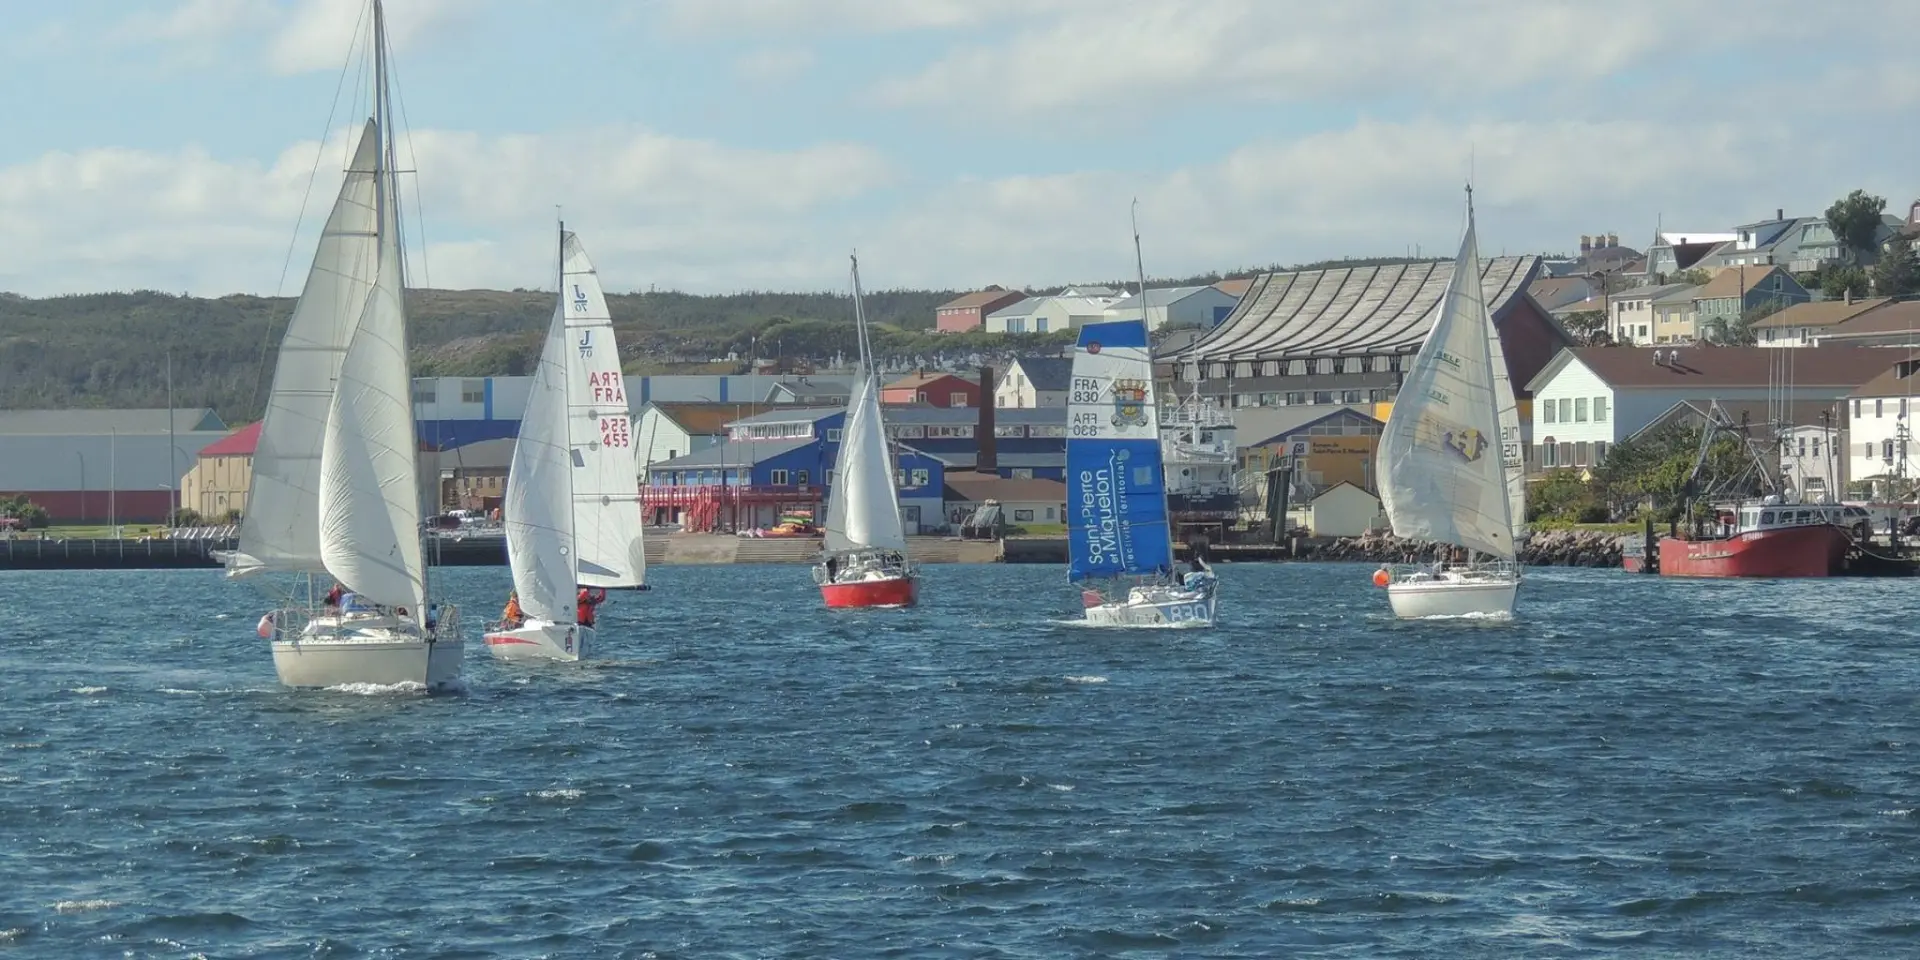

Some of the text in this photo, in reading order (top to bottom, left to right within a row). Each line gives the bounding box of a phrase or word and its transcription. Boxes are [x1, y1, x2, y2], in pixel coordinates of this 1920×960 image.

[580, 330, 591, 346] J
[580, 350, 593, 359] 70
[1074, 379, 1099, 391] FRA
[594, 387, 624, 402] FRA
[1074, 391, 1099, 403] 830
[603, 433, 629, 448] 455
[1080, 470, 1104, 565] Saint-Pierre
[1095, 469, 1119, 564] et Miquelon
[1170, 604, 1208, 621] 830
